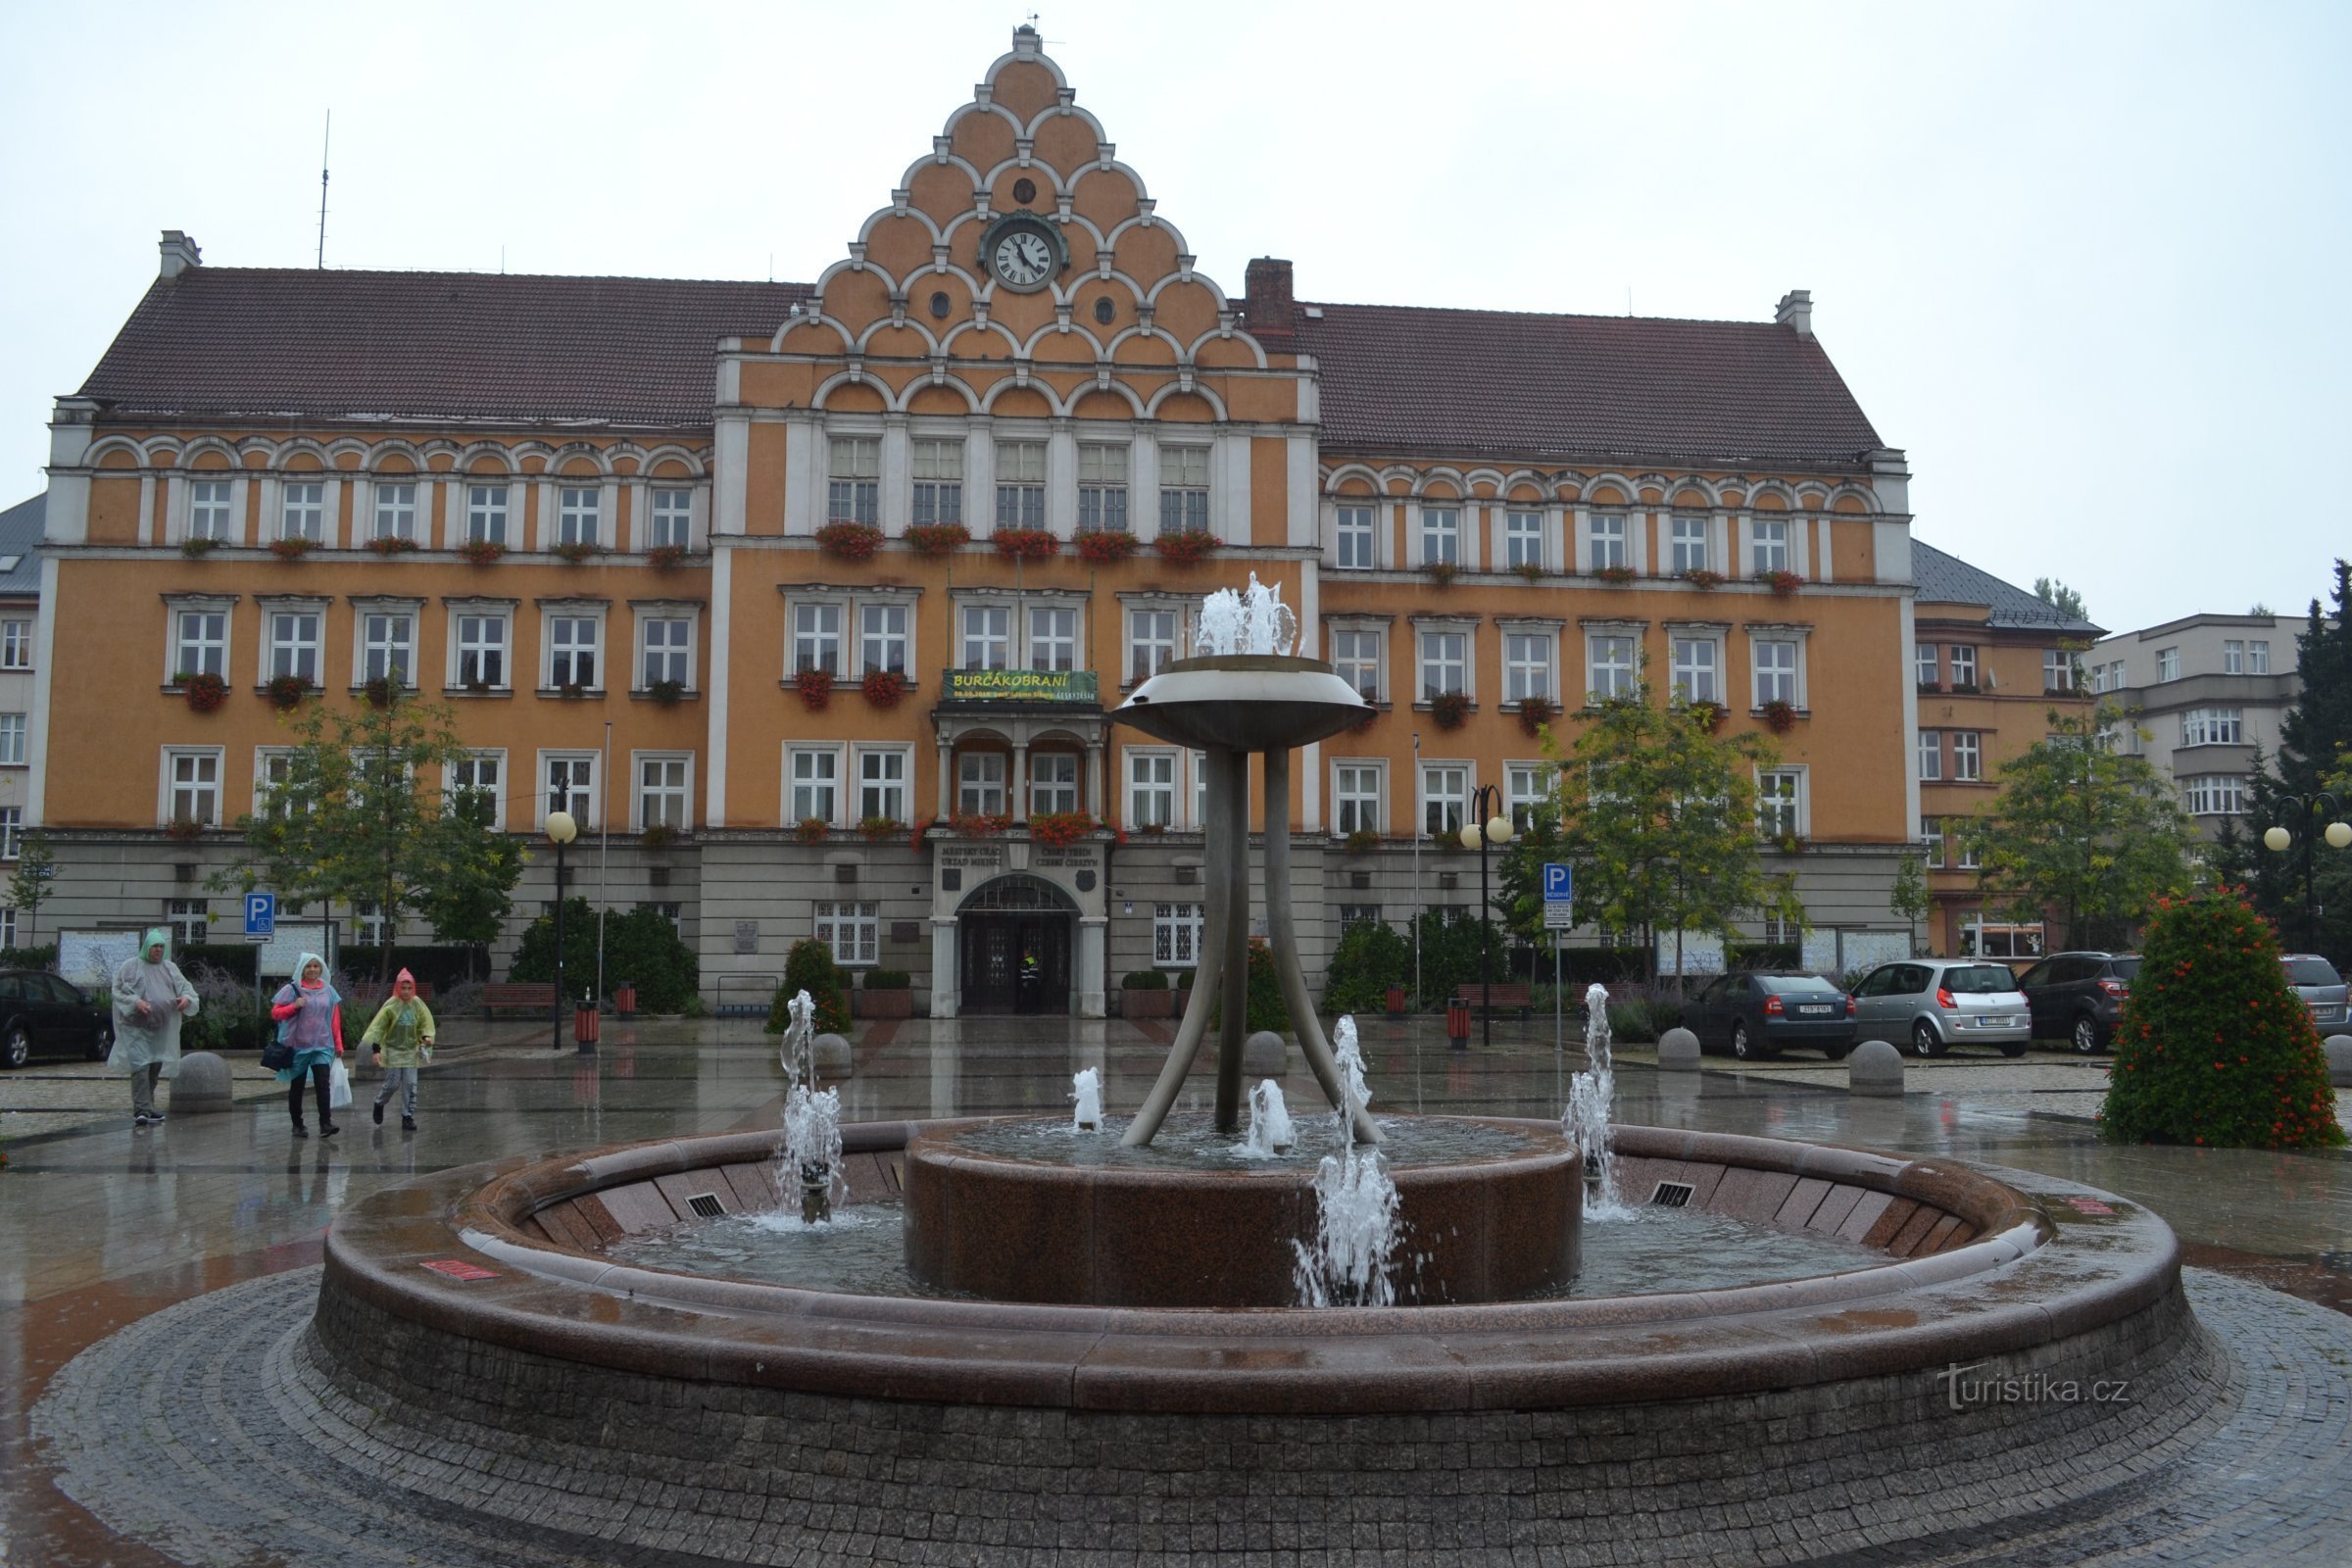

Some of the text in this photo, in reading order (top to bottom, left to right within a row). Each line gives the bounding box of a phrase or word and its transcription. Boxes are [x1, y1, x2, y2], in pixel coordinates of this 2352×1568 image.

[954, 671, 1068, 687] BURČÁKOBRANÍ
[1549, 867, 1566, 890] P
[251, 898, 269, 921] P
